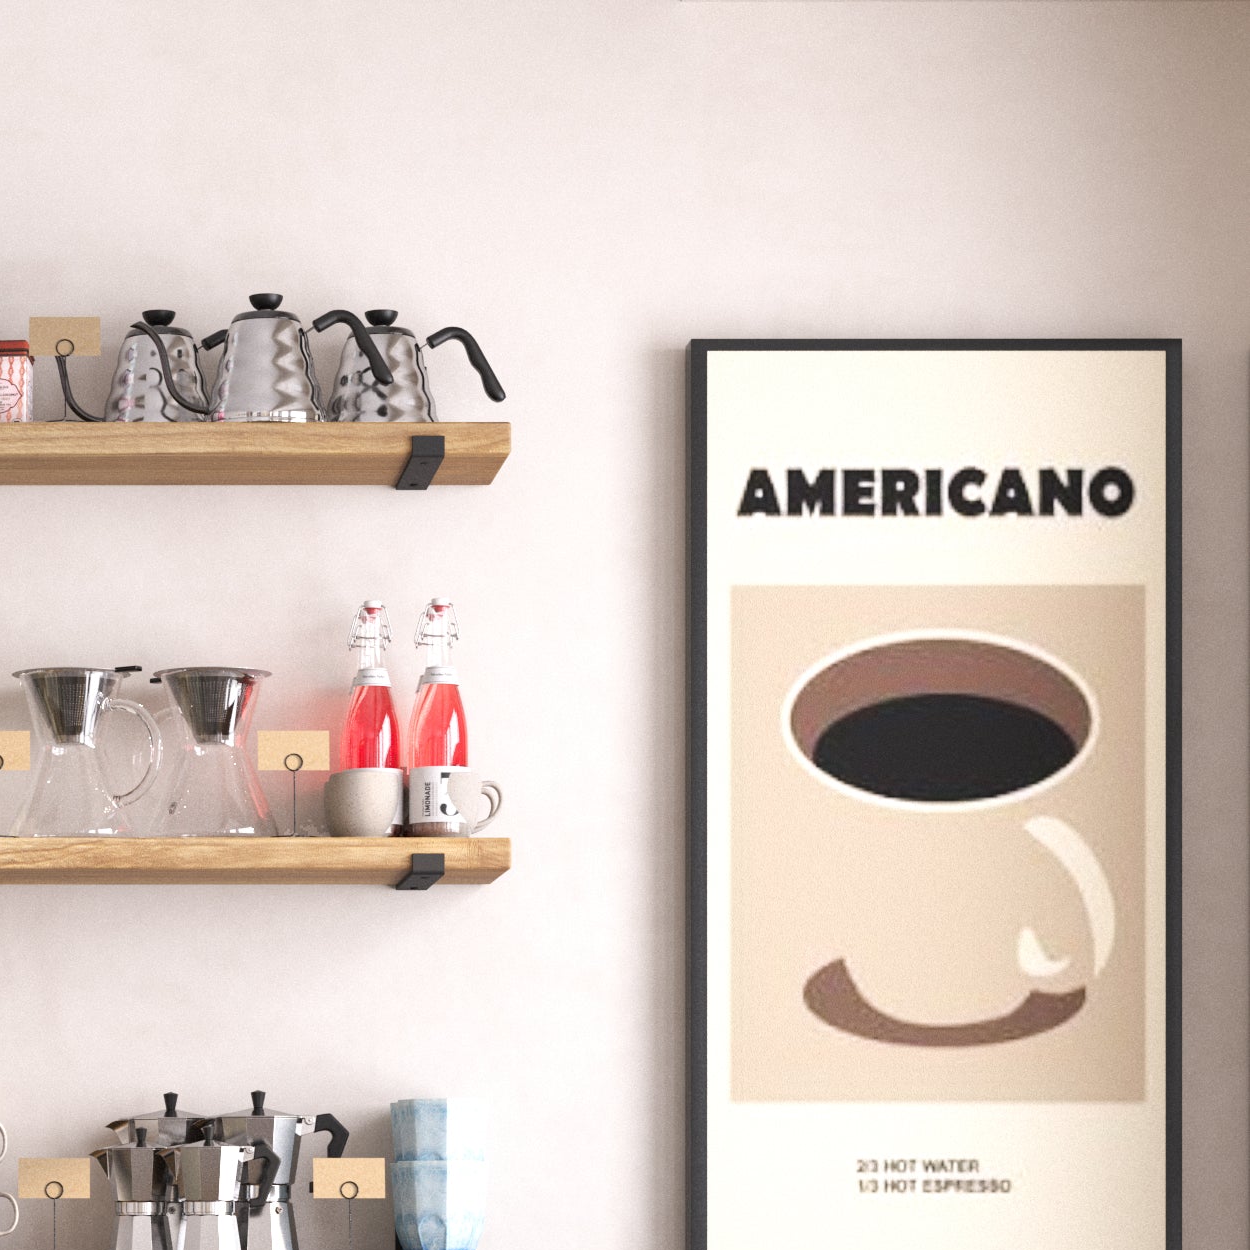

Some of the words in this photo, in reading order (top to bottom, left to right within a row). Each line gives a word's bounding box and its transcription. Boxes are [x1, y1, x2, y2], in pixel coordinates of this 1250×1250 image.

[737, 466, 1136, 518] AMERICANO
[884, 1159, 916, 1173] HOT
[922, 1159, 980, 1173] WATER
[884, 1179, 916, 1193] HOT
[922, 1179, 1012, 1193] ESPRESSO
